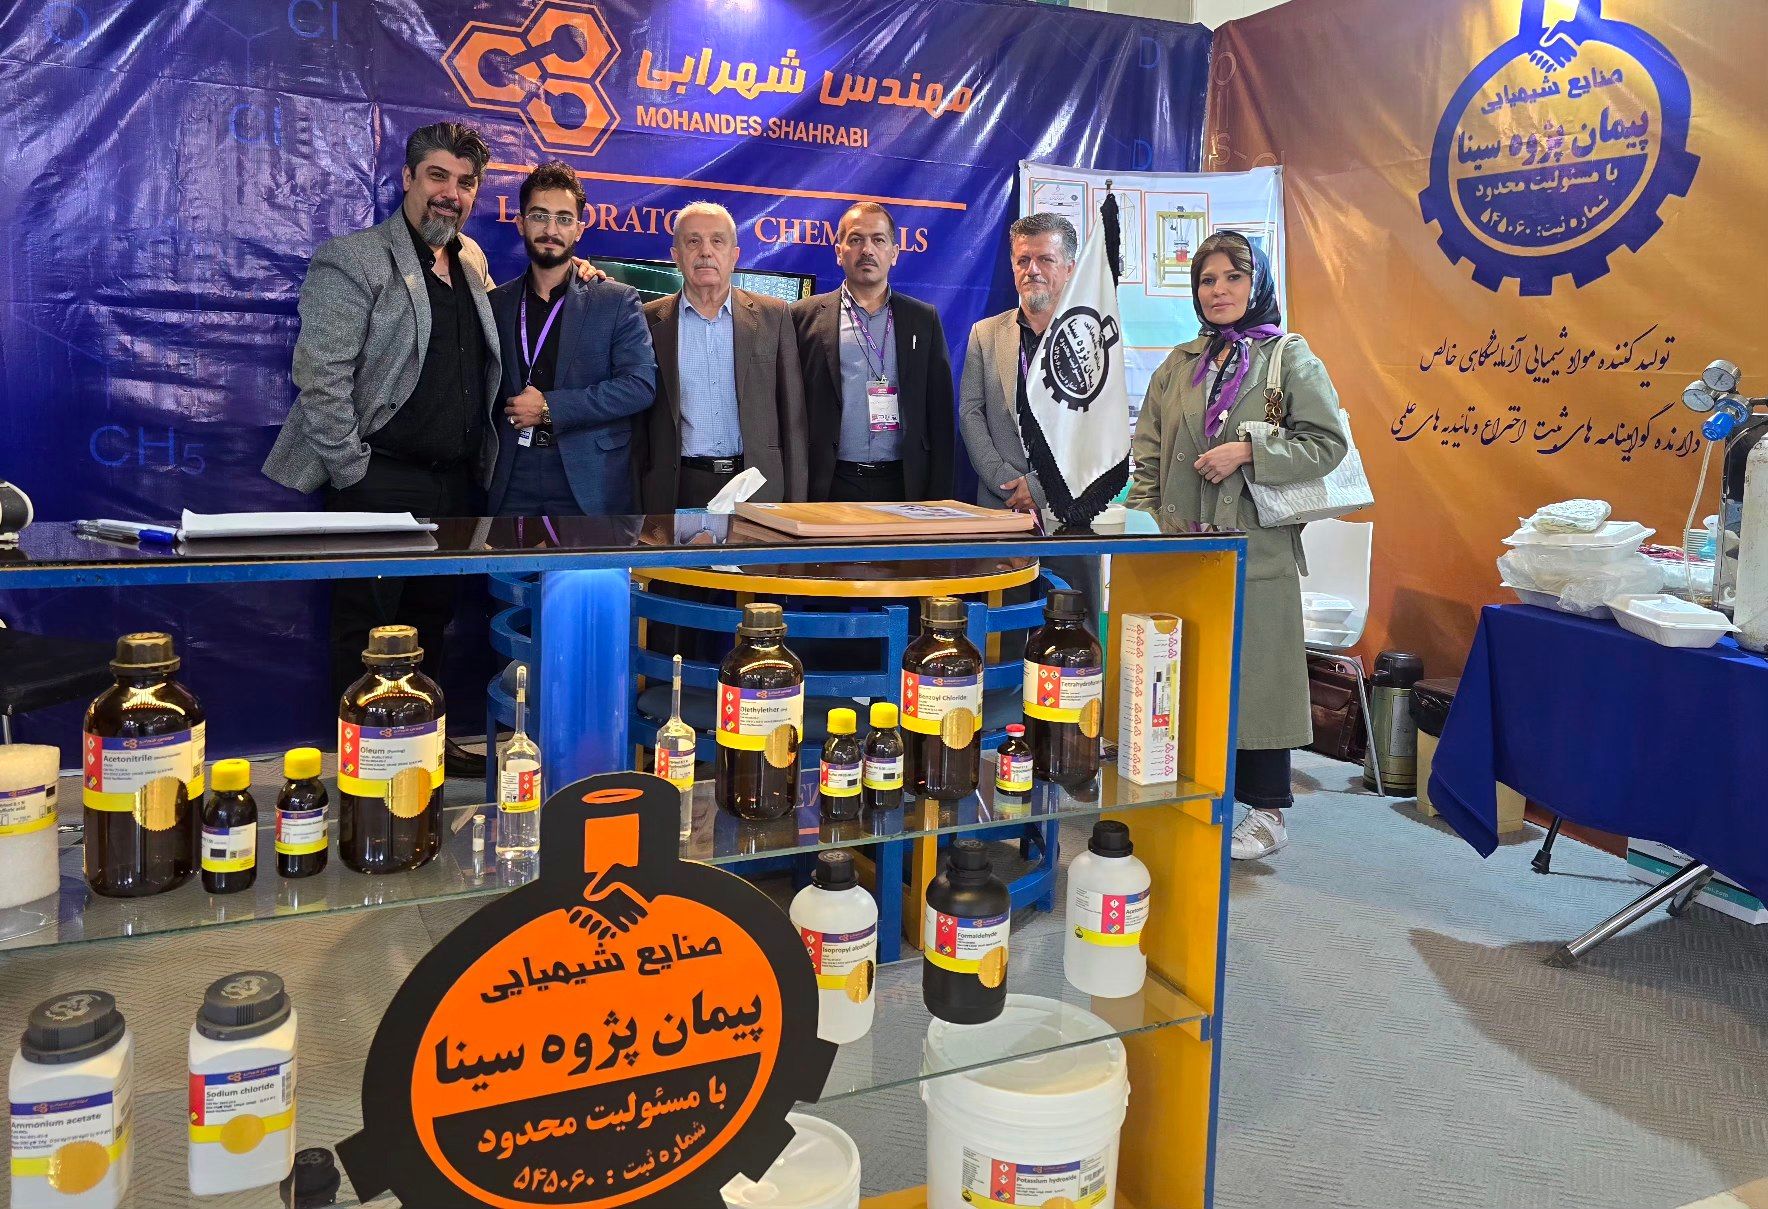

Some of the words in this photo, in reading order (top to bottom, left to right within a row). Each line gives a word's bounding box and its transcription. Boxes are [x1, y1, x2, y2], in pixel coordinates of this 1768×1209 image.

[636, 47, 807, 100] شهرابی
[1567, 67, 1624, 99] صنایع
[819, 69, 974, 120] مهندس
[1480, 75, 1561, 115] شیمیایی
[636, 104, 869, 149] MOHANDES.SHAHRABI
[1508, 120, 1564, 167] پژوه
[1572, 106, 1649, 158] پیمان
[1457, 130, 1501, 171] سینا
[1475, 181, 1526, 202] محدود
[1530, 167, 1600, 193] مسئولیت
[1605, 162, 1618, 186] با
[1570, 195, 1609, 229] شماره
[754, 216, 928, 253] CHEMLS
[1067, 318, 1079, 339] سینا
[1597, 323, 1659, 371] کننده
[1419, 336, 1458, 372] خالص
[1458, 328, 1528, 374] آزمایشگاهی
[1525, 326, 1568, 384] شیمیایی
[1566, 348, 1596, 375] مواد
[1633, 336, 1676, 389] تولید
[1390, 400, 1417, 436] علمی
[1395, 407, 1440, 442] های
[1480, 405, 1527, 446] اختراع
[1533, 405, 1569, 448] ثبت
[1536, 416, 1593, 455] های
[1594, 400, 1676, 463] گواهینامه
[1654, 426, 1701, 458] دارنده
[103, 754, 153, 763] Acetonitrile
[360, 746, 385, 755] Oleum
[637, 931, 723, 977] صنایع
[823, 946, 851, 954] Isopropyl
[957, 930, 998, 939] Formaldehyde
[479, 940, 626, 1005] شیمیایی
[651, 989, 765, 1058] پیمان
[540, 1009, 640, 1078] پژوه
[433, 1035, 526, 1093] سینا
[206, 1089, 239, 1099] Sodium
[240, 1082, 275, 1095] chloride
[585, 1086, 702, 1133] مسئولیت
[708, 1074, 729, 1110] با
[11, 1119, 65, 1129] Ammonium
[66, 1113, 102, 1125] acetate
[476, 1114, 578, 1161] محدود
[659, 1120, 708, 1164] شماره
[513, 1165, 595, 1194] ۵۴۵۰۶۰
[1016, 1176, 1048, 1184] Potassium
[1048, 1174, 1078, 1184] hydroxide
